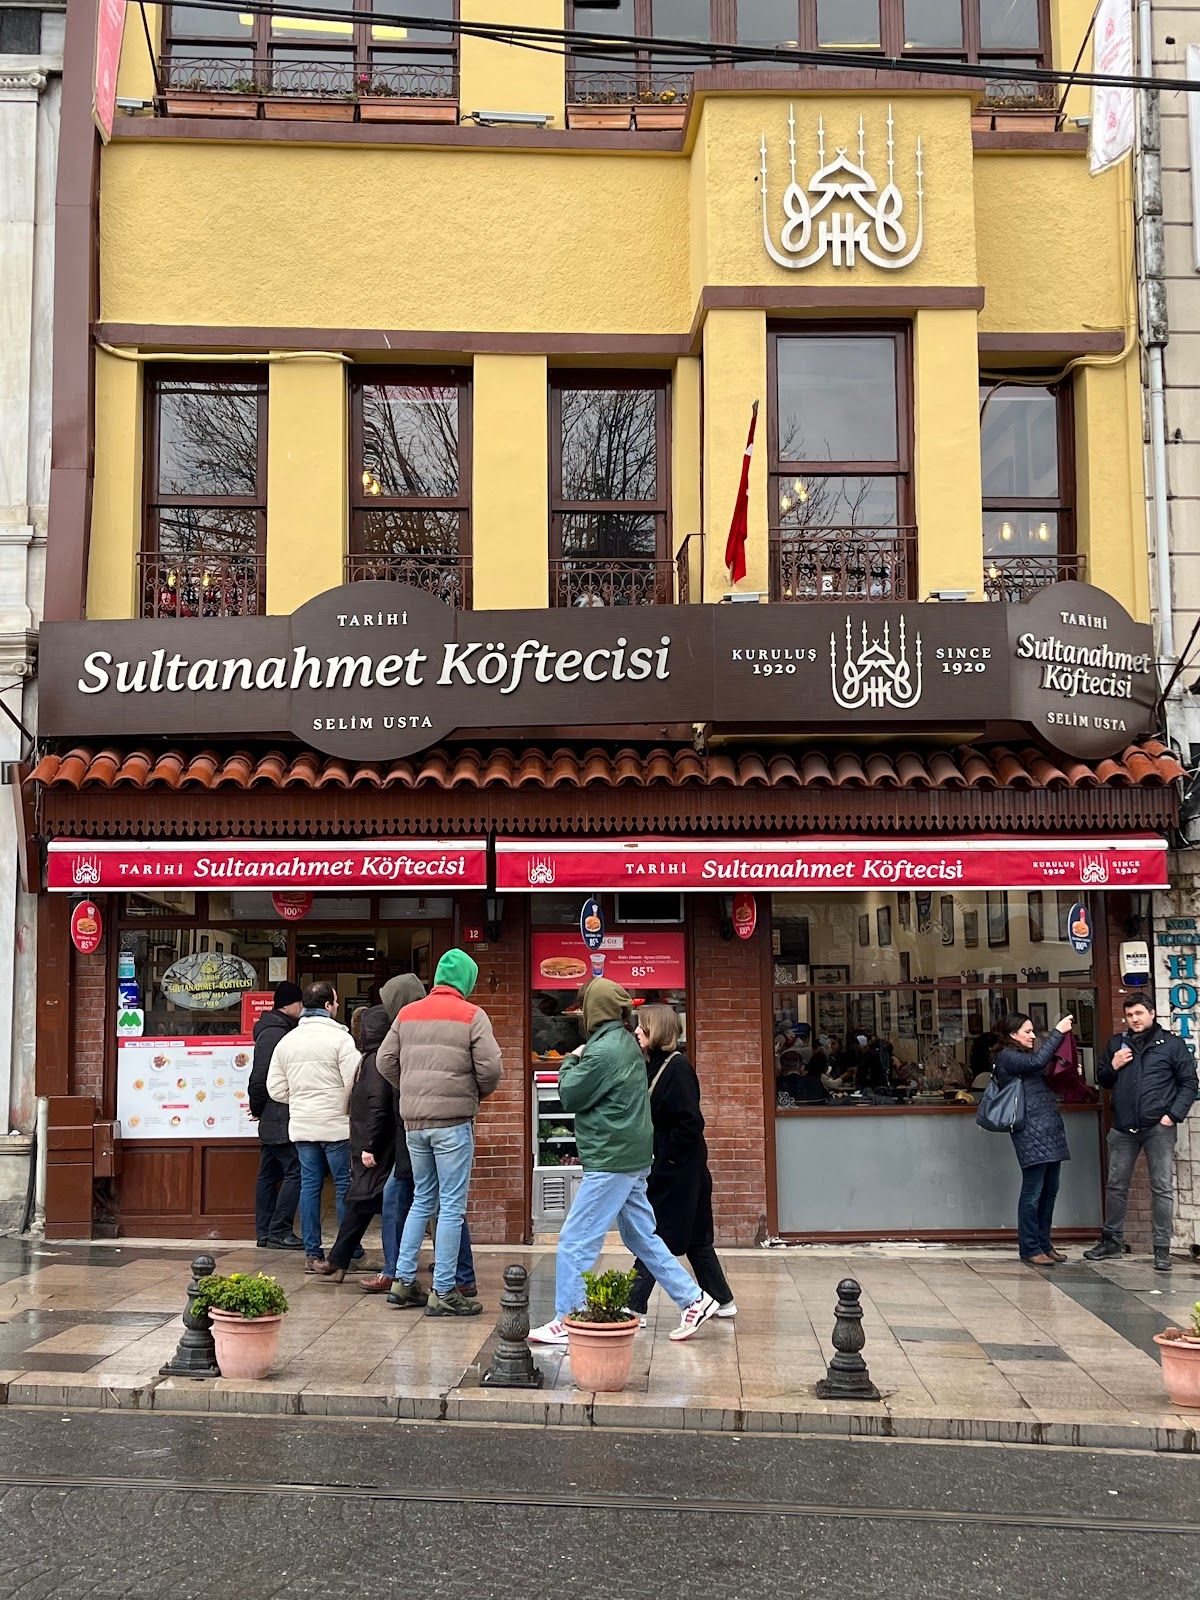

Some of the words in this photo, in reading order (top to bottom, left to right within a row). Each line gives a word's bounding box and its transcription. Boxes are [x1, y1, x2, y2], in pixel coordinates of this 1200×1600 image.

[336, 611, 408, 627] TARİHİ
[1060, 611, 1108, 630] TARİHİ
[732, 648, 817, 662] KURULUŞ
[936, 648, 992, 659] SINCE
[1017, 632, 1151, 674] Sultanahmet
[77, 646, 428, 694] Sultanahmet
[436, 635, 671, 695] Köftecisi
[752, 663, 797, 677] 1920
[942, 662, 986, 675] 1920
[1043, 664, 1132, 699] Köftecisi
[313, 715, 373, 731] SELİM
[383, 715, 433, 729] USTA
[1047, 711, 1089, 728] SELİM
[1094, 717, 1127, 732] USTA
[119, 862, 183, 875] TARİHİ
[193, 857, 354, 878] Sultanahmet
[360, 855, 466, 880] Köftecisi
[625, 862, 687, 874] TARİHİ
[702, 859, 856, 879] Sultanahmet
[862, 859, 964, 882] Köftecisi
[1111, 860, 1141, 868] SINCE
[1115, 867, 1138, 875] 1920
[470, 929, 479, 939] 12
